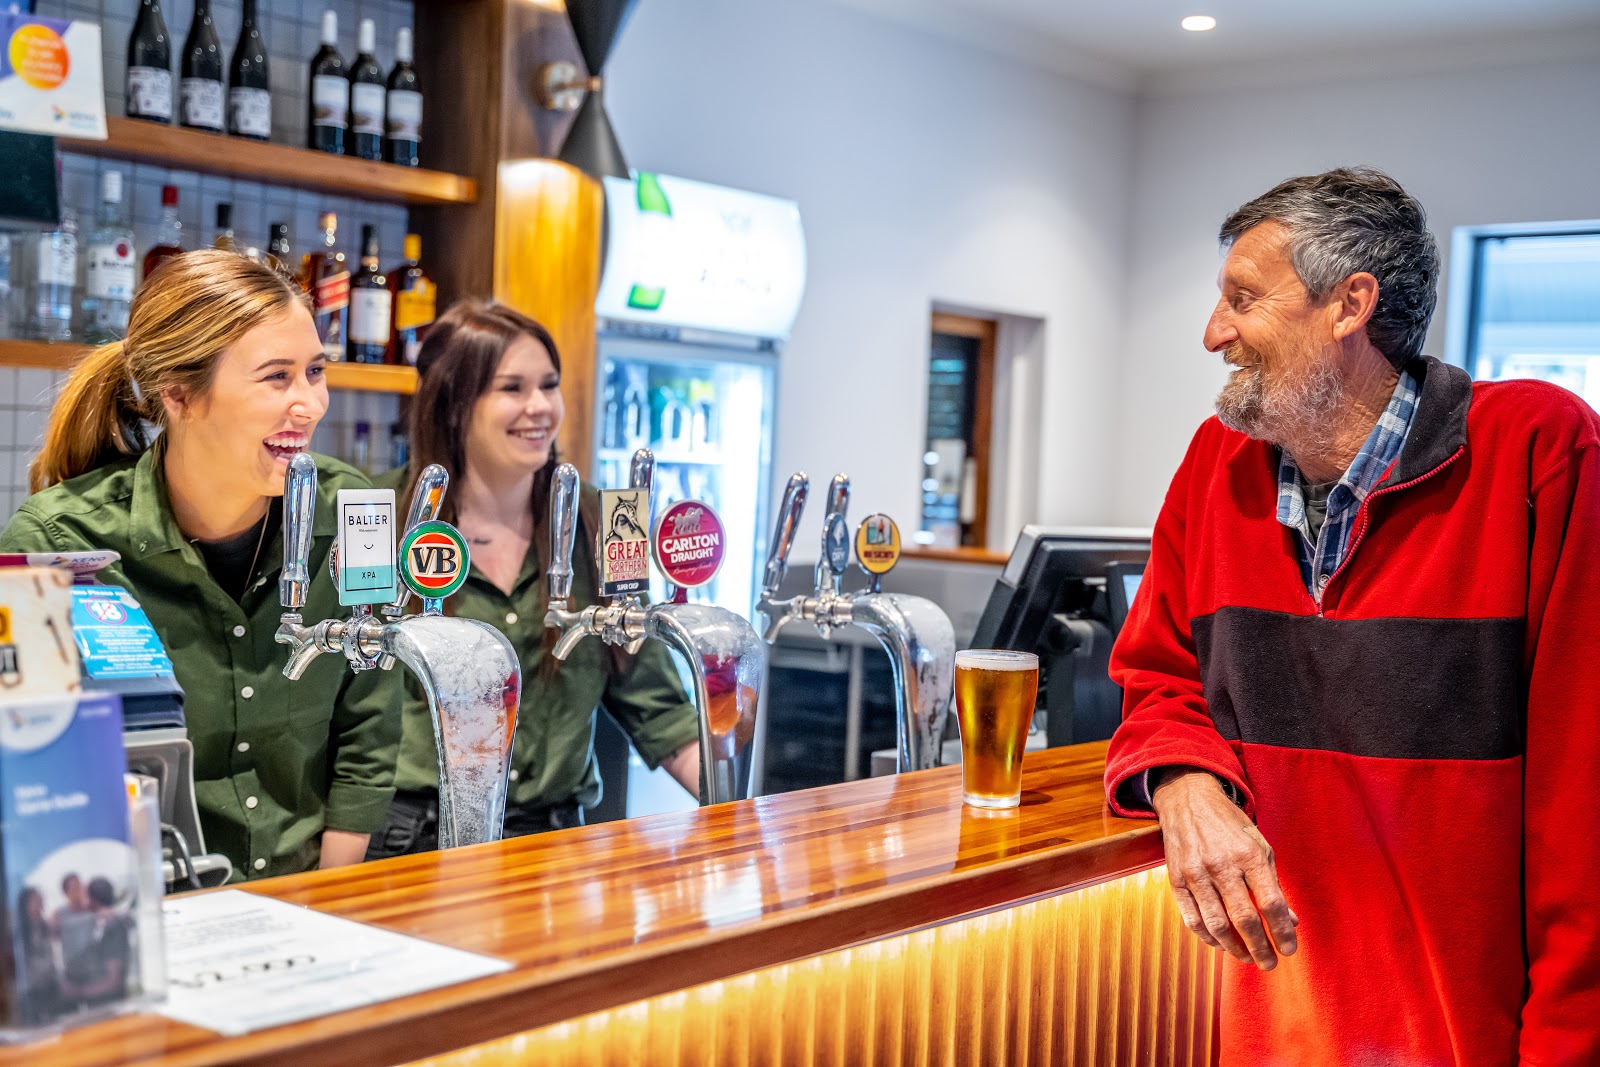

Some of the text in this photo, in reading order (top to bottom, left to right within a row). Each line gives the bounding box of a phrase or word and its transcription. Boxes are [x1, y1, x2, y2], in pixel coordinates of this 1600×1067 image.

[348, 515, 388, 526] BALTER
[662, 533, 719, 553] CARLTON
[607, 541, 647, 561] GREAT
[671, 548, 714, 563] DRAUGHT
[411, 547, 457, 574] VB
[609, 560, 647, 573] NORTHERN
[361, 571, 376, 579] XPA
